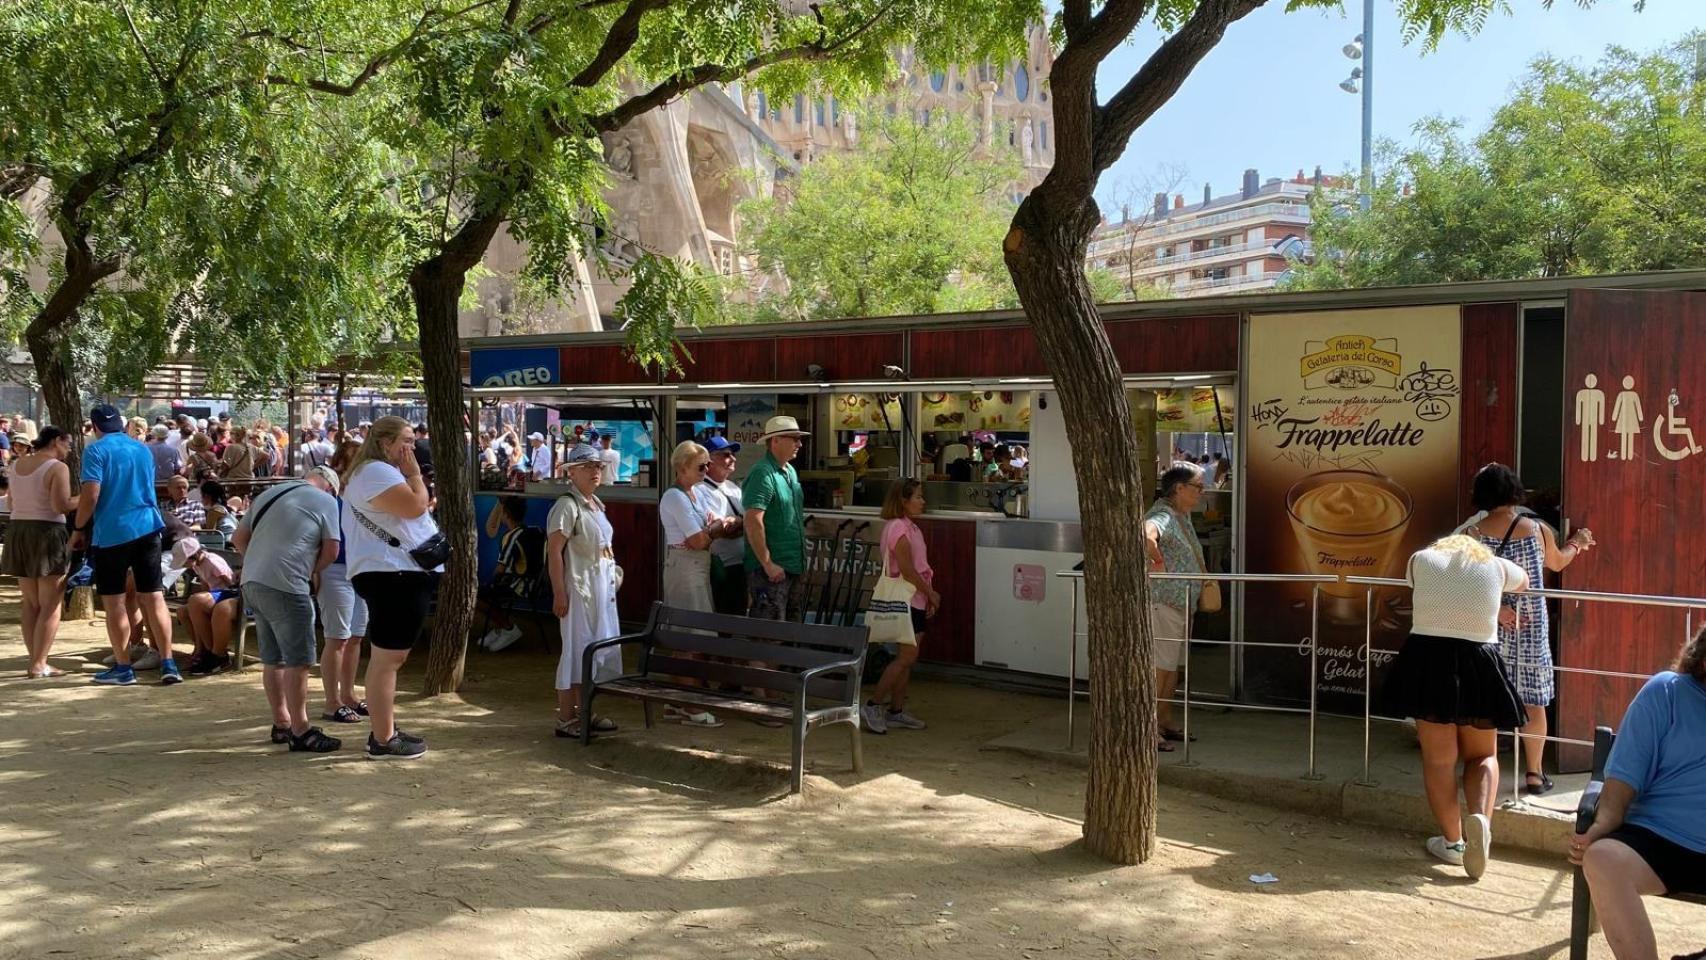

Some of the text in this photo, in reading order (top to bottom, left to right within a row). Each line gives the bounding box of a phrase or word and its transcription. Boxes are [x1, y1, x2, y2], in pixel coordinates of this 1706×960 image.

[1306, 352, 1394, 369] Gelateria del Corso
